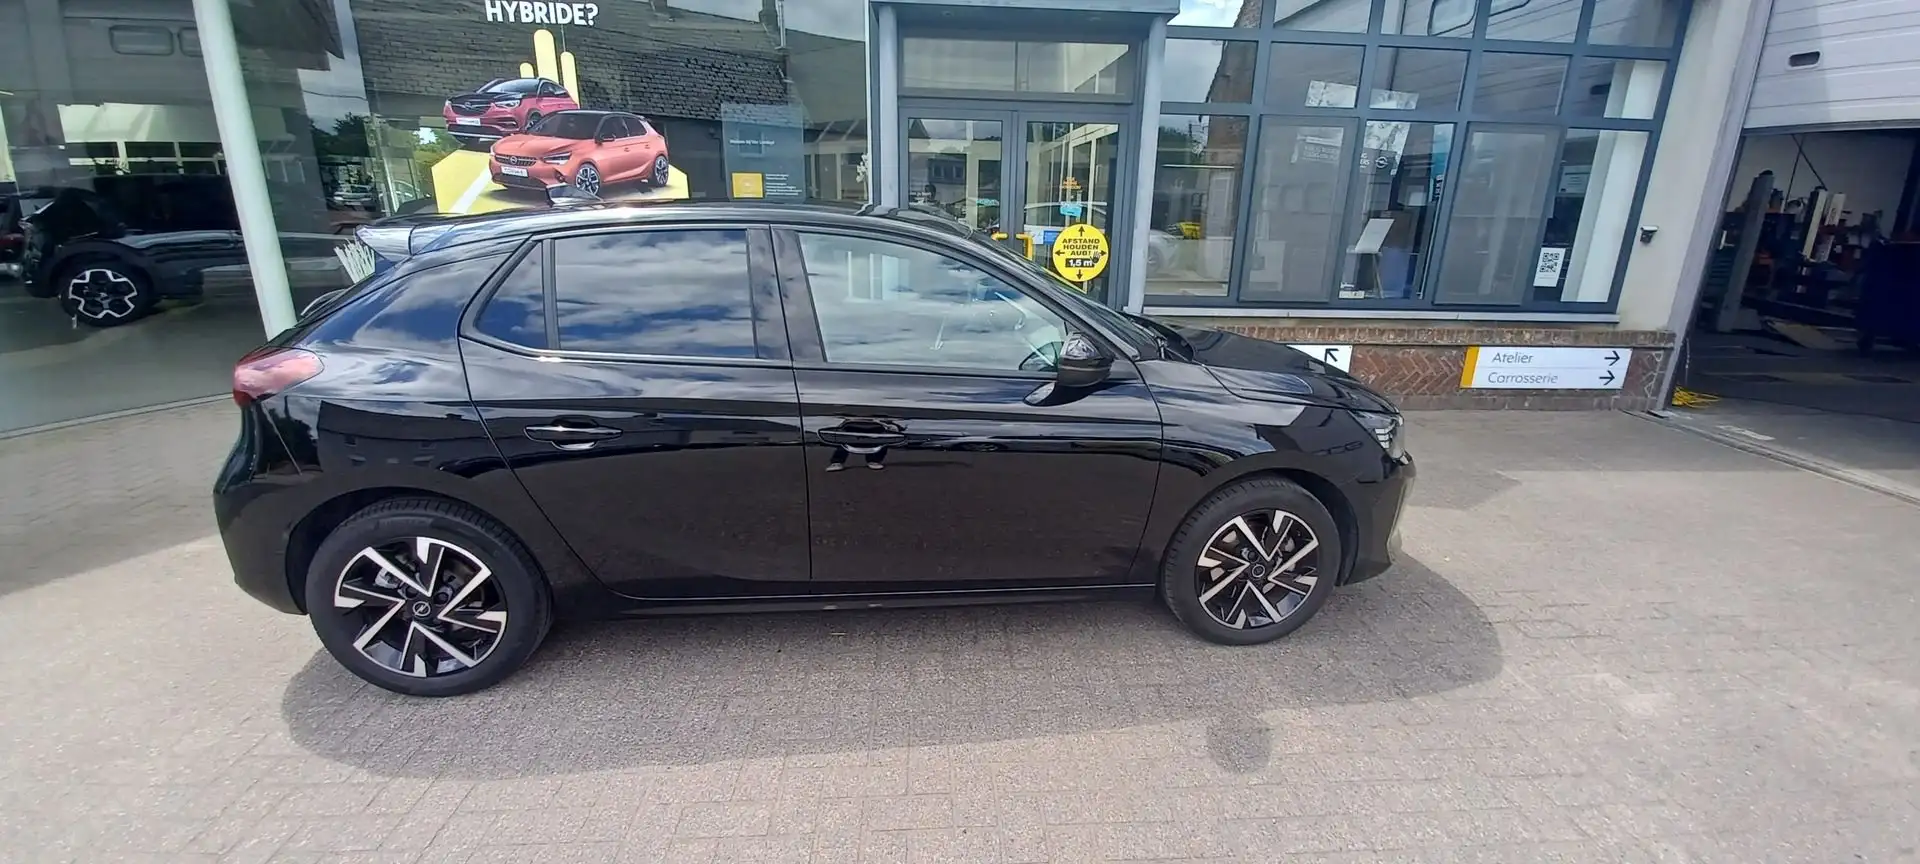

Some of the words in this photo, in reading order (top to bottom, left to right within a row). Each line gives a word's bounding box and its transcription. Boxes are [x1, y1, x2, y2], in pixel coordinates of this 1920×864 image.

[485, 0, 598, 25] HYBRIDE?
[1069, 259, 1082, 267] 1,5
[1492, 352, 1534, 363] Atelier
[1488, 372, 1558, 384] Carrosserie
